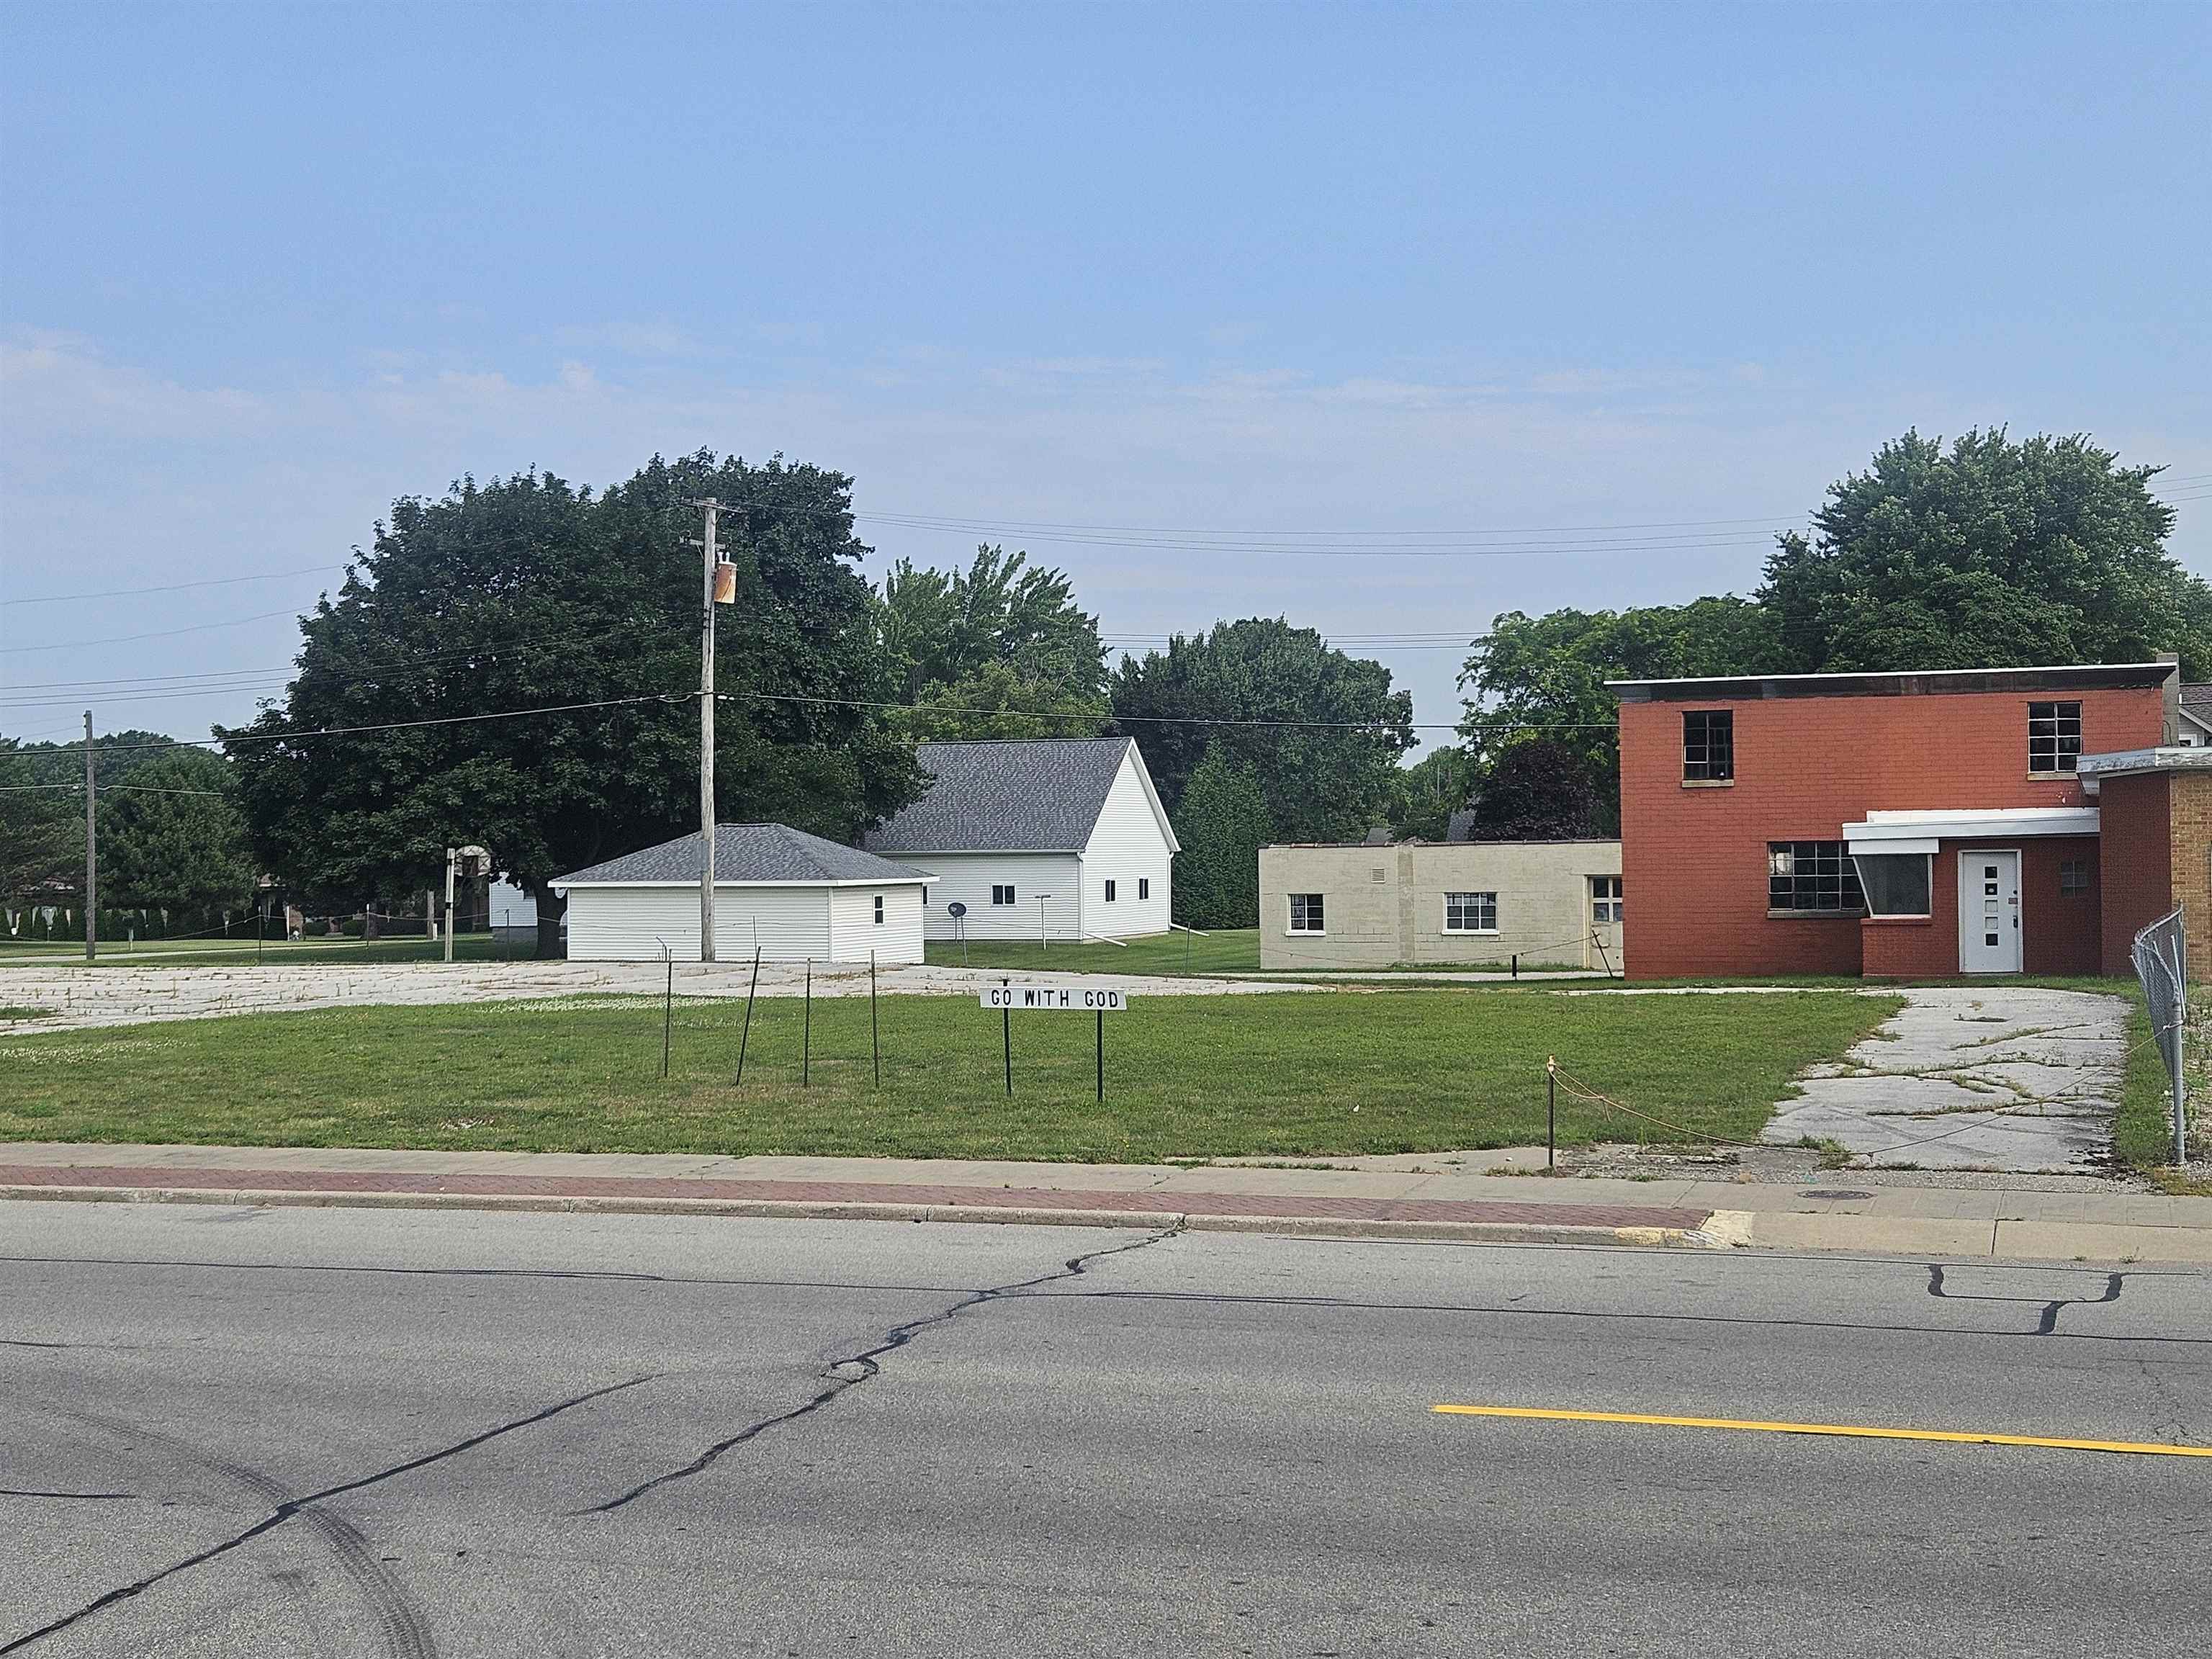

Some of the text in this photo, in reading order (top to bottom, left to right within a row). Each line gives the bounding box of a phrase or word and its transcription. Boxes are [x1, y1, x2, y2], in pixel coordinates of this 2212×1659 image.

[992, 989, 1118, 1007] GO WITH GOD
